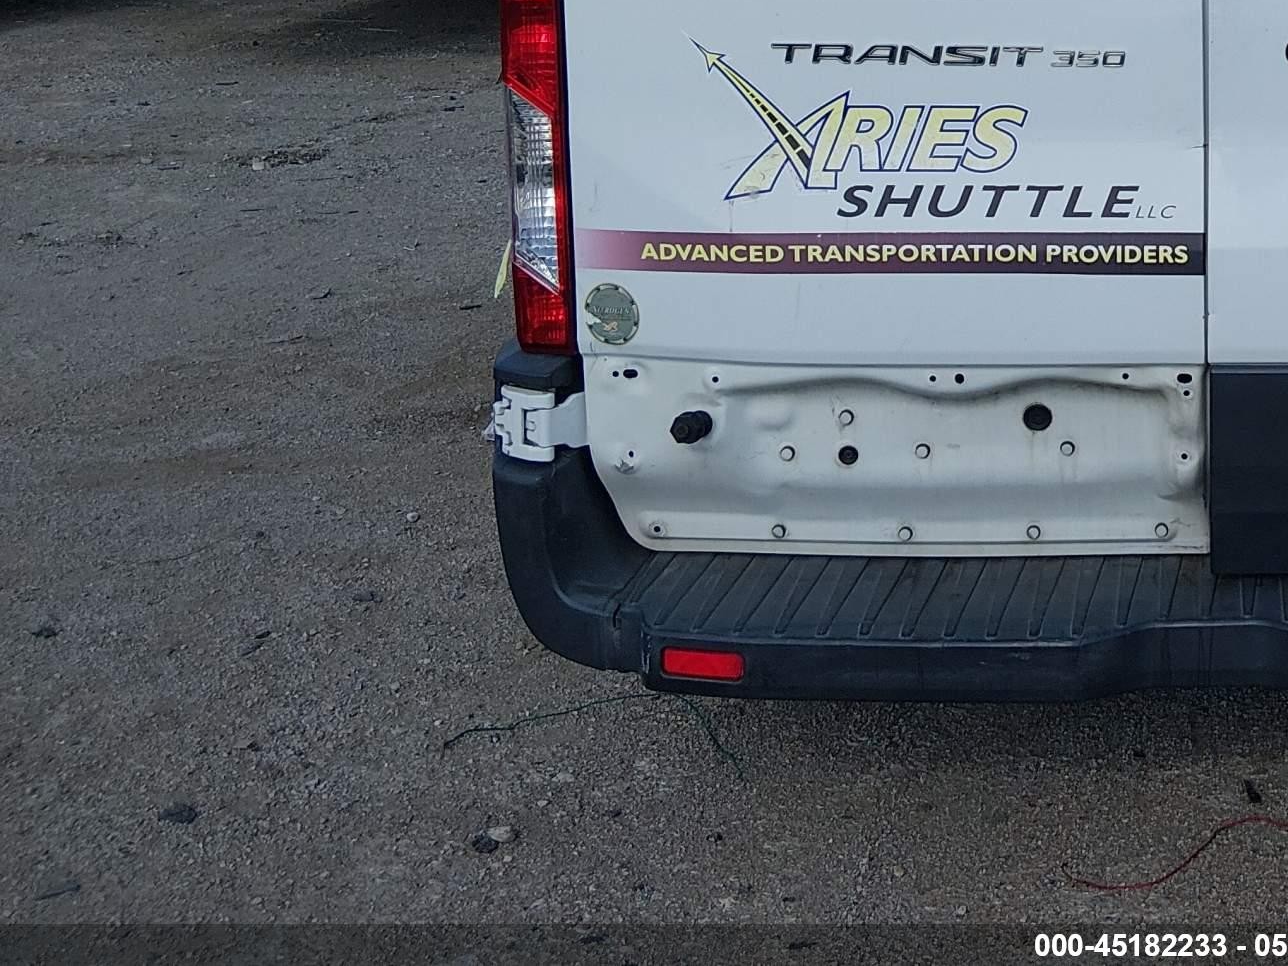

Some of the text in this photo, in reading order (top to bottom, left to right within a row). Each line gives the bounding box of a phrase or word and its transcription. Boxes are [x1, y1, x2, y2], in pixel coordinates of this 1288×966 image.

[770, 43, 1126, 68] TRANSIT 350
[700, 59, 1029, 201] ARIES
[836, 184, 1177, 219] SHUTTLE LLC
[640, 242, 1189, 264] ADVANCED TRANSPORTATION PROVIDERS
